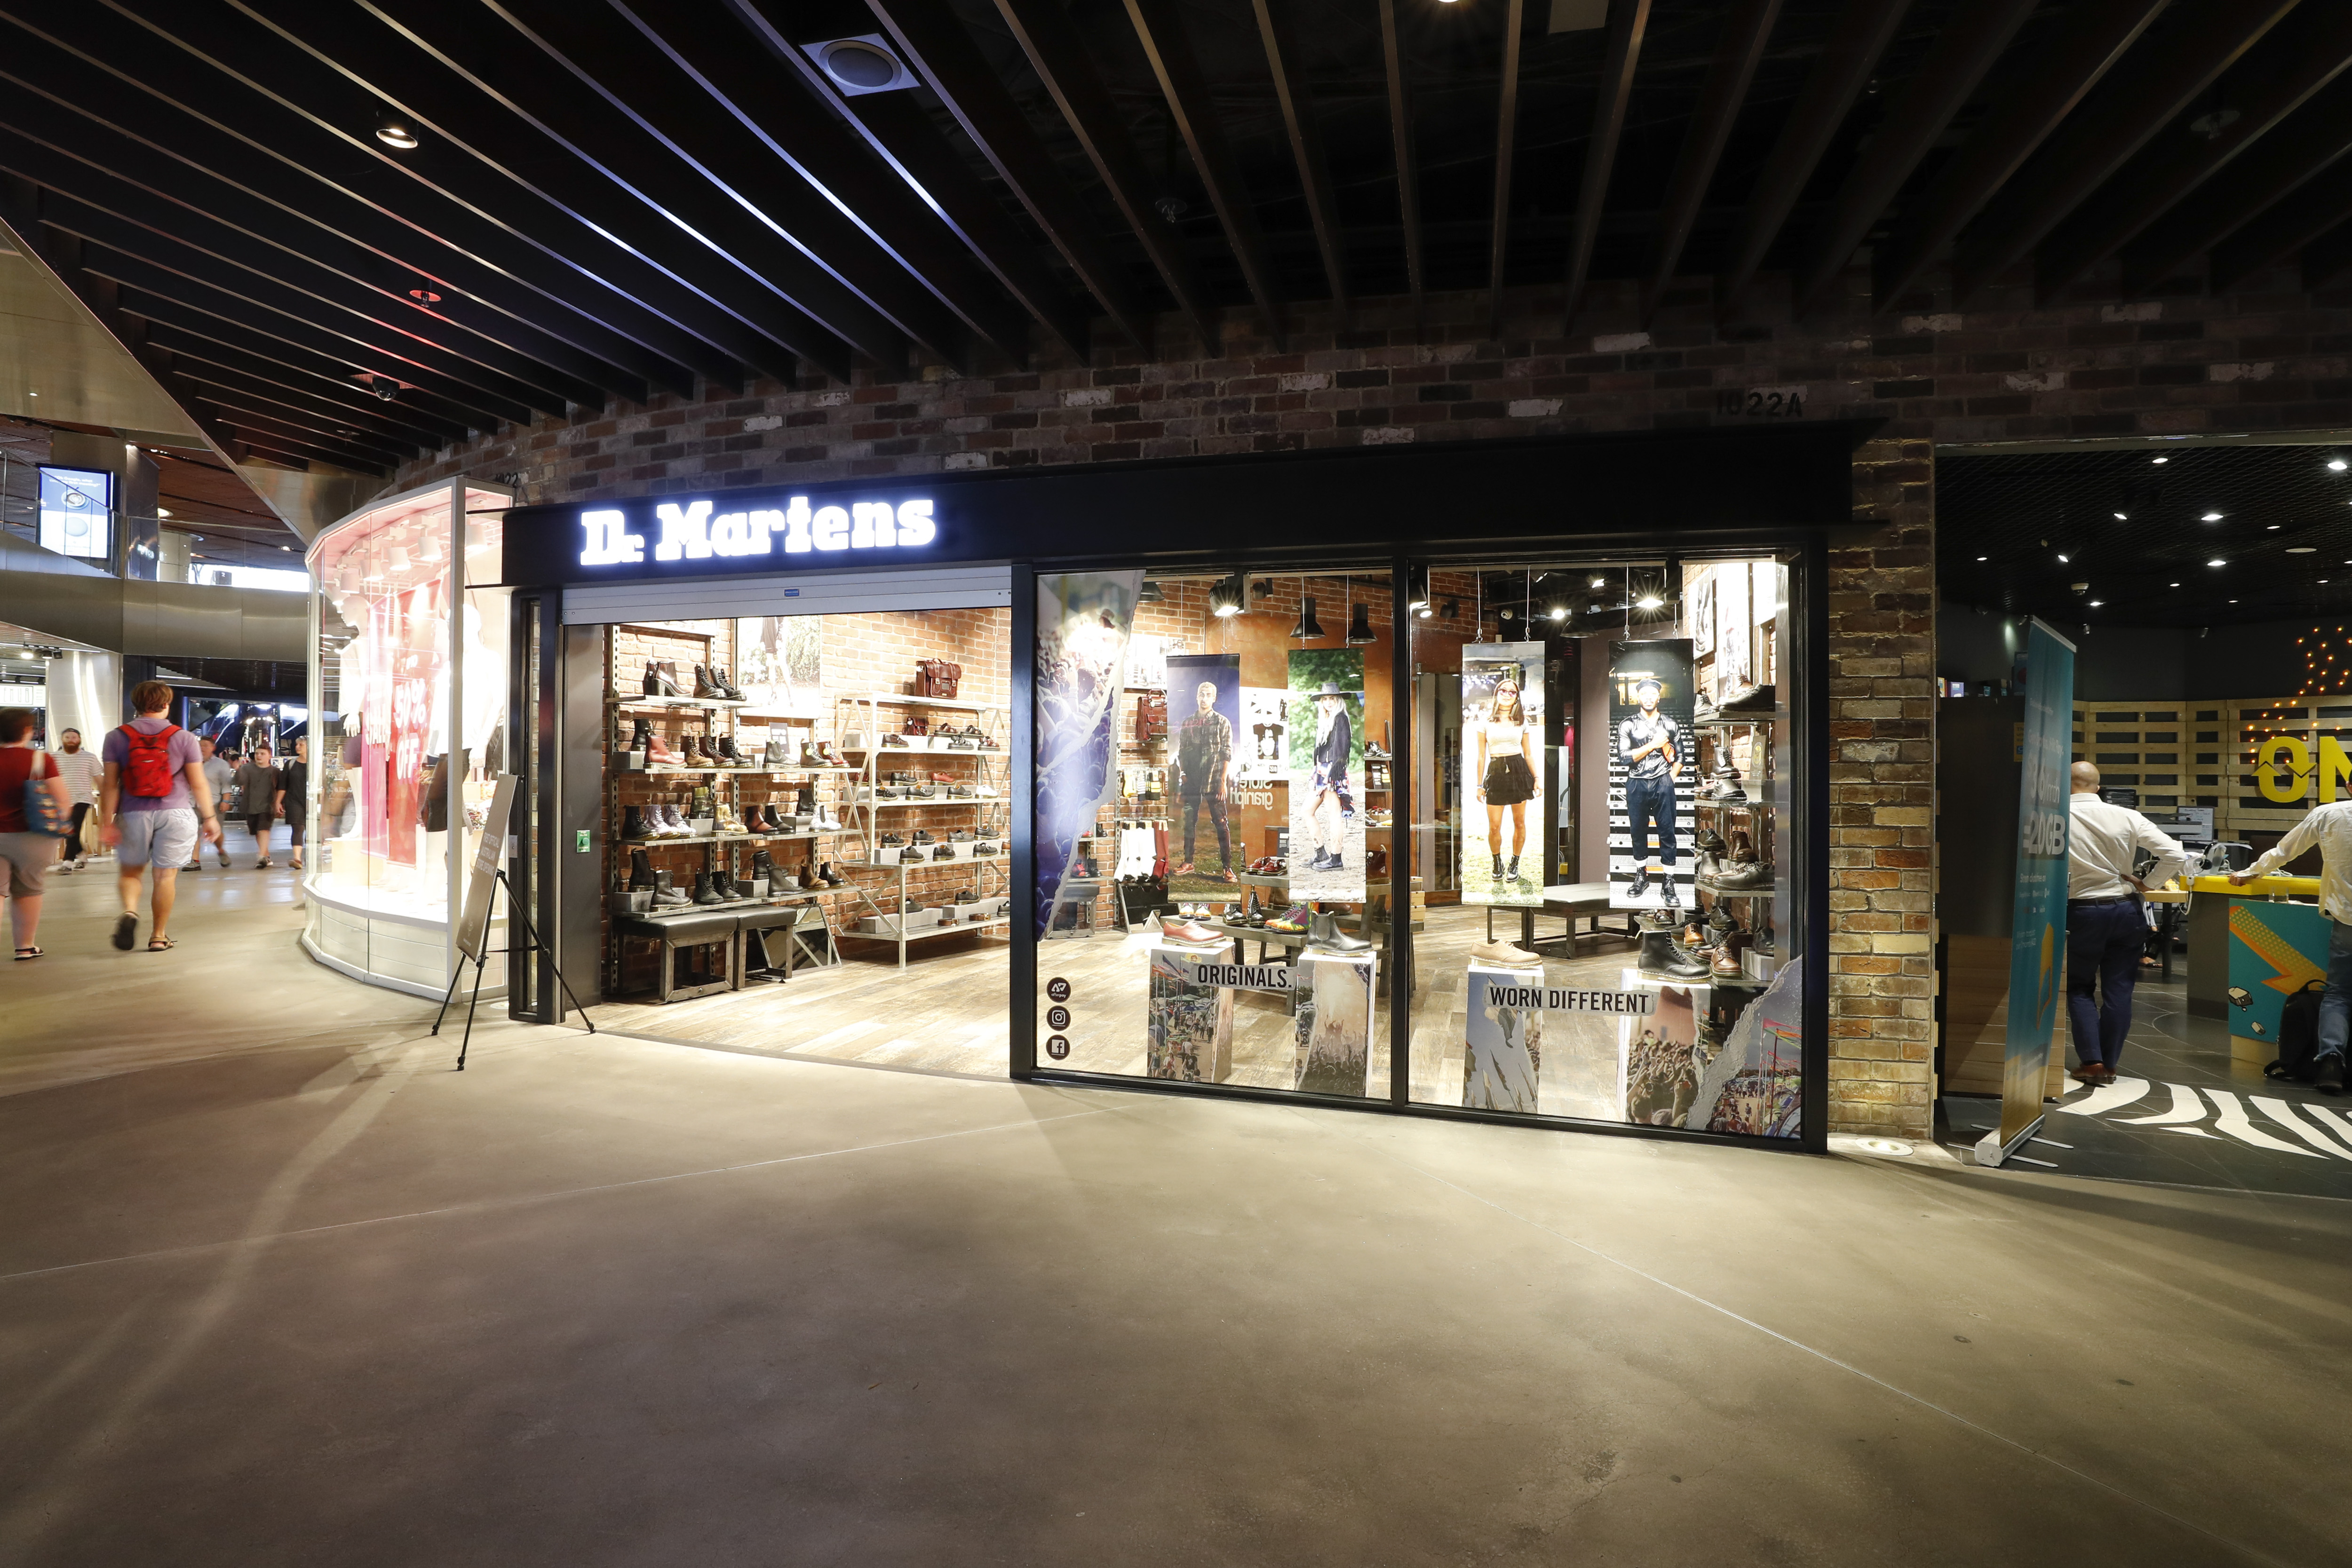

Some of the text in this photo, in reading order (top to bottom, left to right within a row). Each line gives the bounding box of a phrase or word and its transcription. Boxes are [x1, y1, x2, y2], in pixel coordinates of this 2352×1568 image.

[1716, 392, 1803, 418] 1022A
[655, 496, 936, 560] Martens
[394, 679, 426, 729] 50%
[397, 738, 419, 780] OFF
[1198, 964, 1293, 988] ORIGINALS.
[1490, 987, 1649, 1013] WORN DIFFERENT
